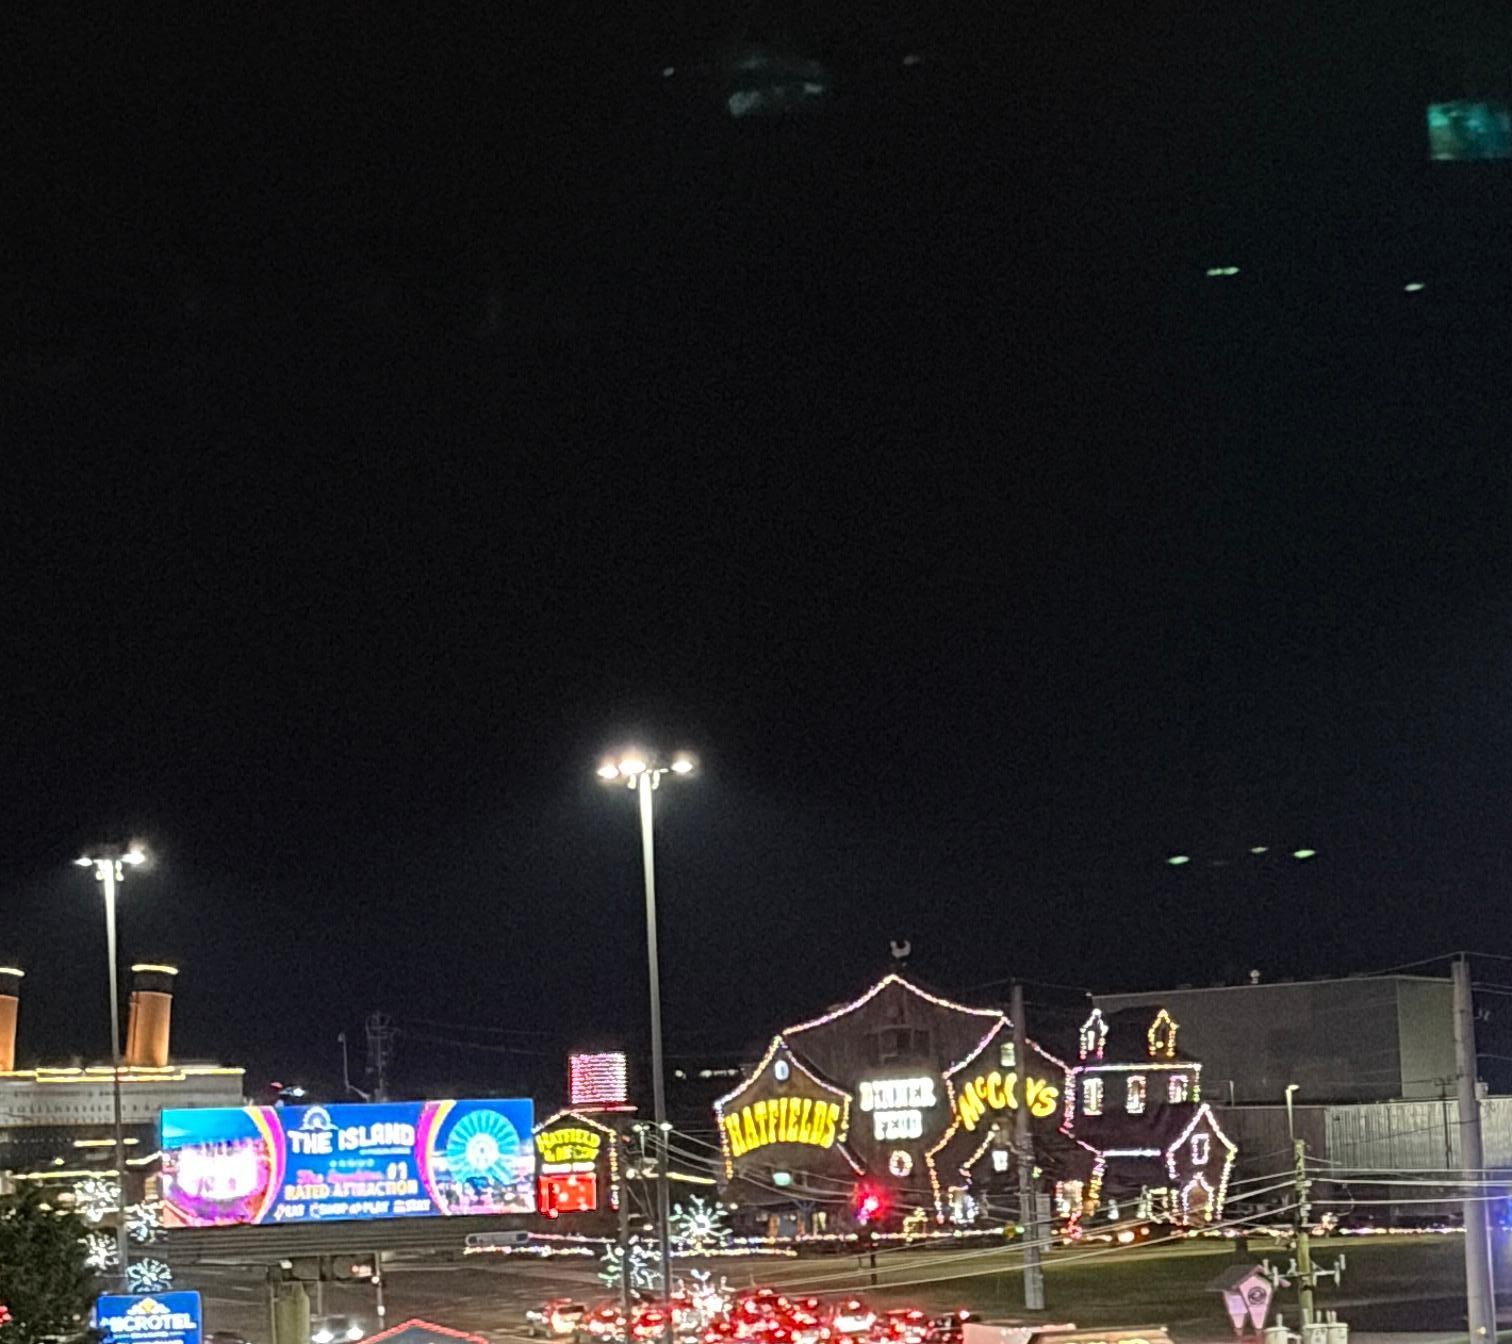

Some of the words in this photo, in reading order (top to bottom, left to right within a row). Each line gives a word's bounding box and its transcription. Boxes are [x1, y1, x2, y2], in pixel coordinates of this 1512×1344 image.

[859, 1077, 937, 1111] DINNER
[287, 1130, 333, 1154] THE
[338, 1123, 415, 1151] ISLAND
[725, 1097, 840, 1157] HATFIELDS
